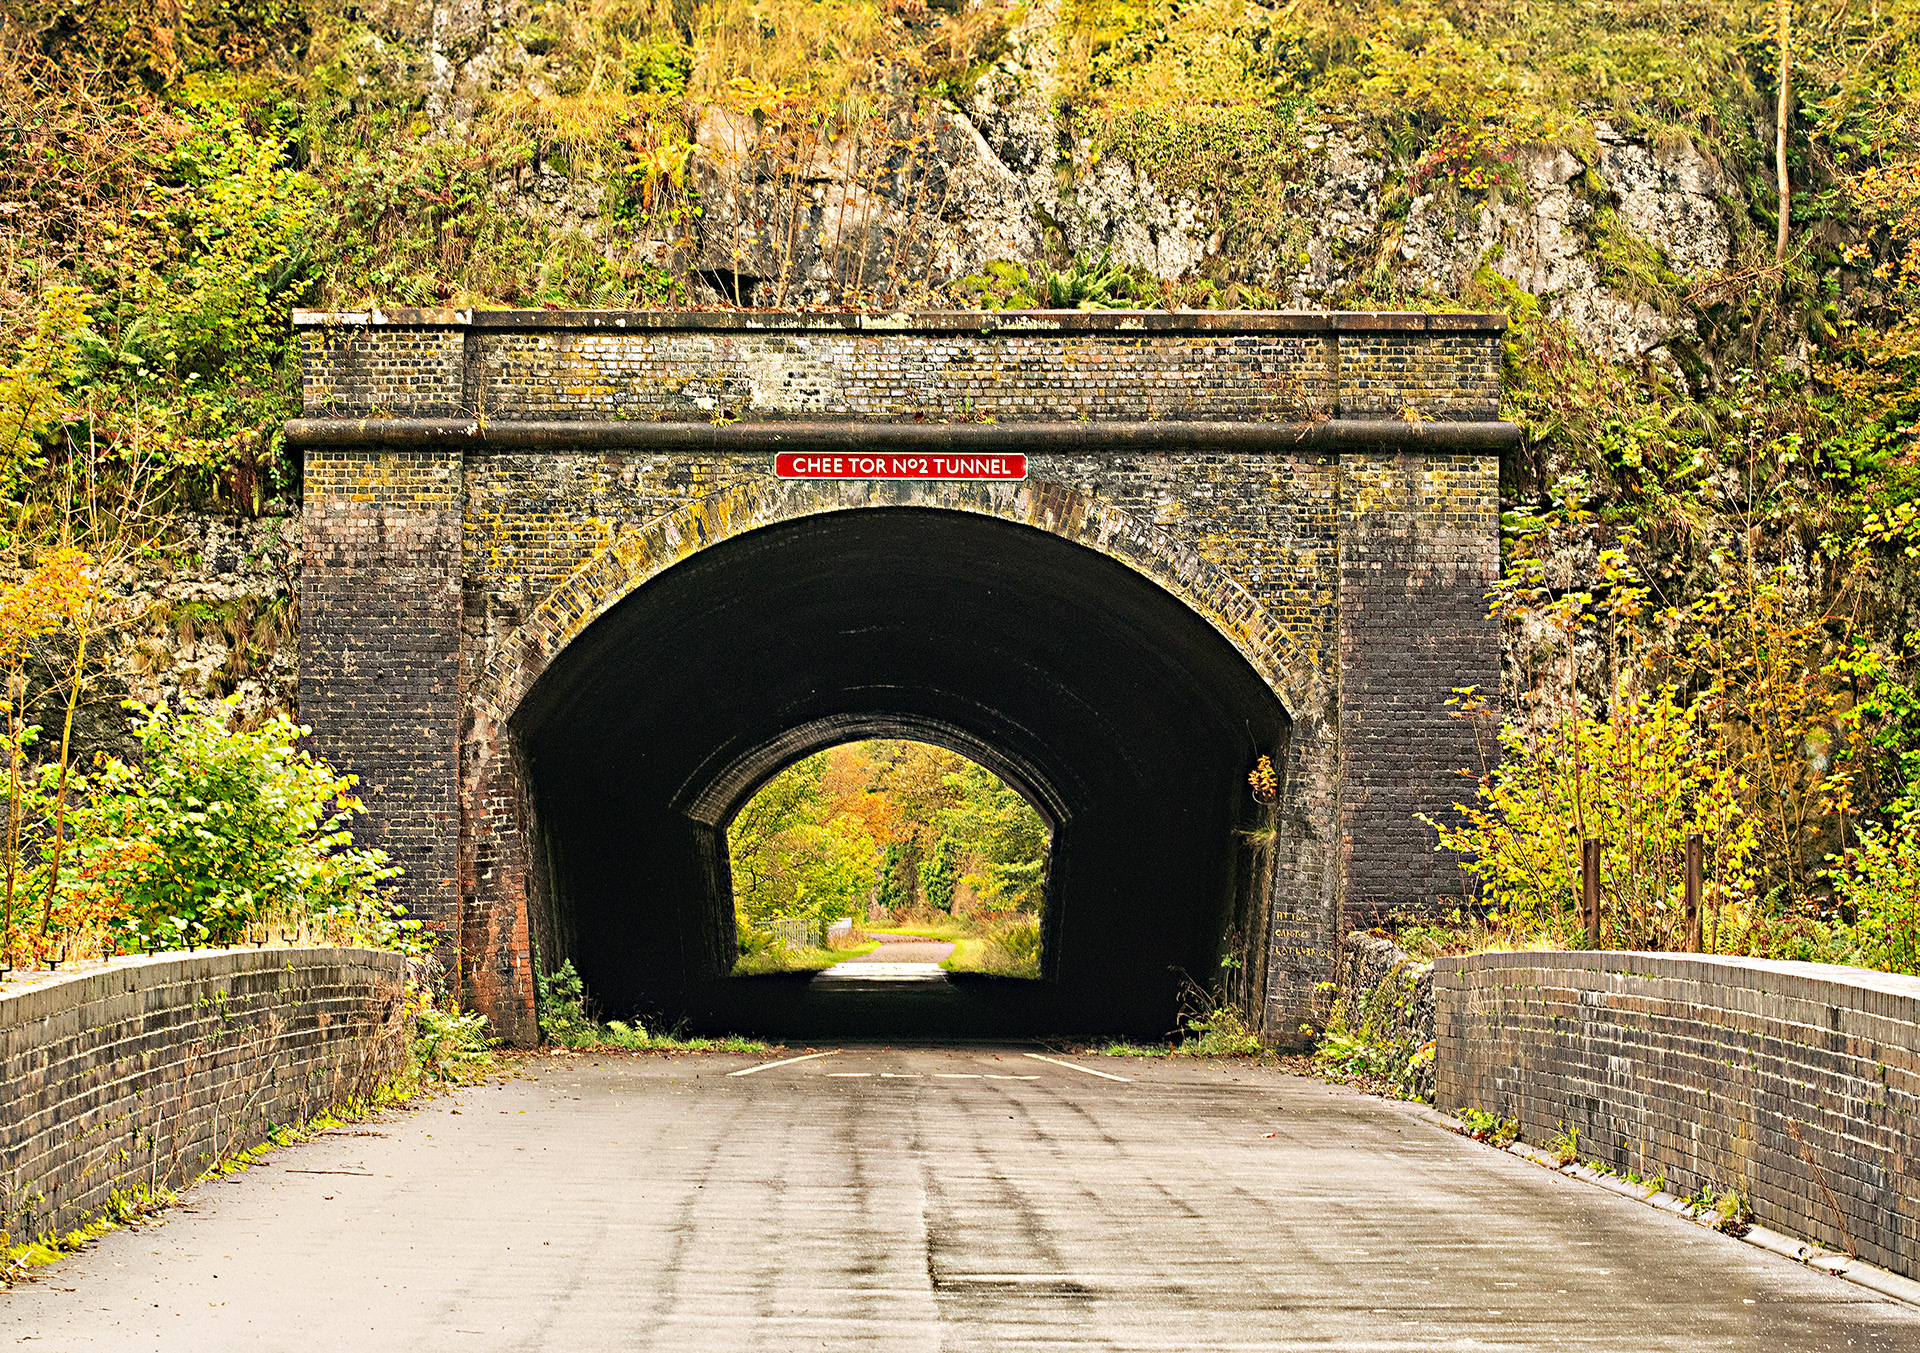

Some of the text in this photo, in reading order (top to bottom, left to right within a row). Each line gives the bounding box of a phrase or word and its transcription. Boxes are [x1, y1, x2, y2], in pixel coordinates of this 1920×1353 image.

[792, 457, 843, 473] CHEE
[847, 458, 888, 474] TOR
[933, 458, 1012, 475] TUNNEL
